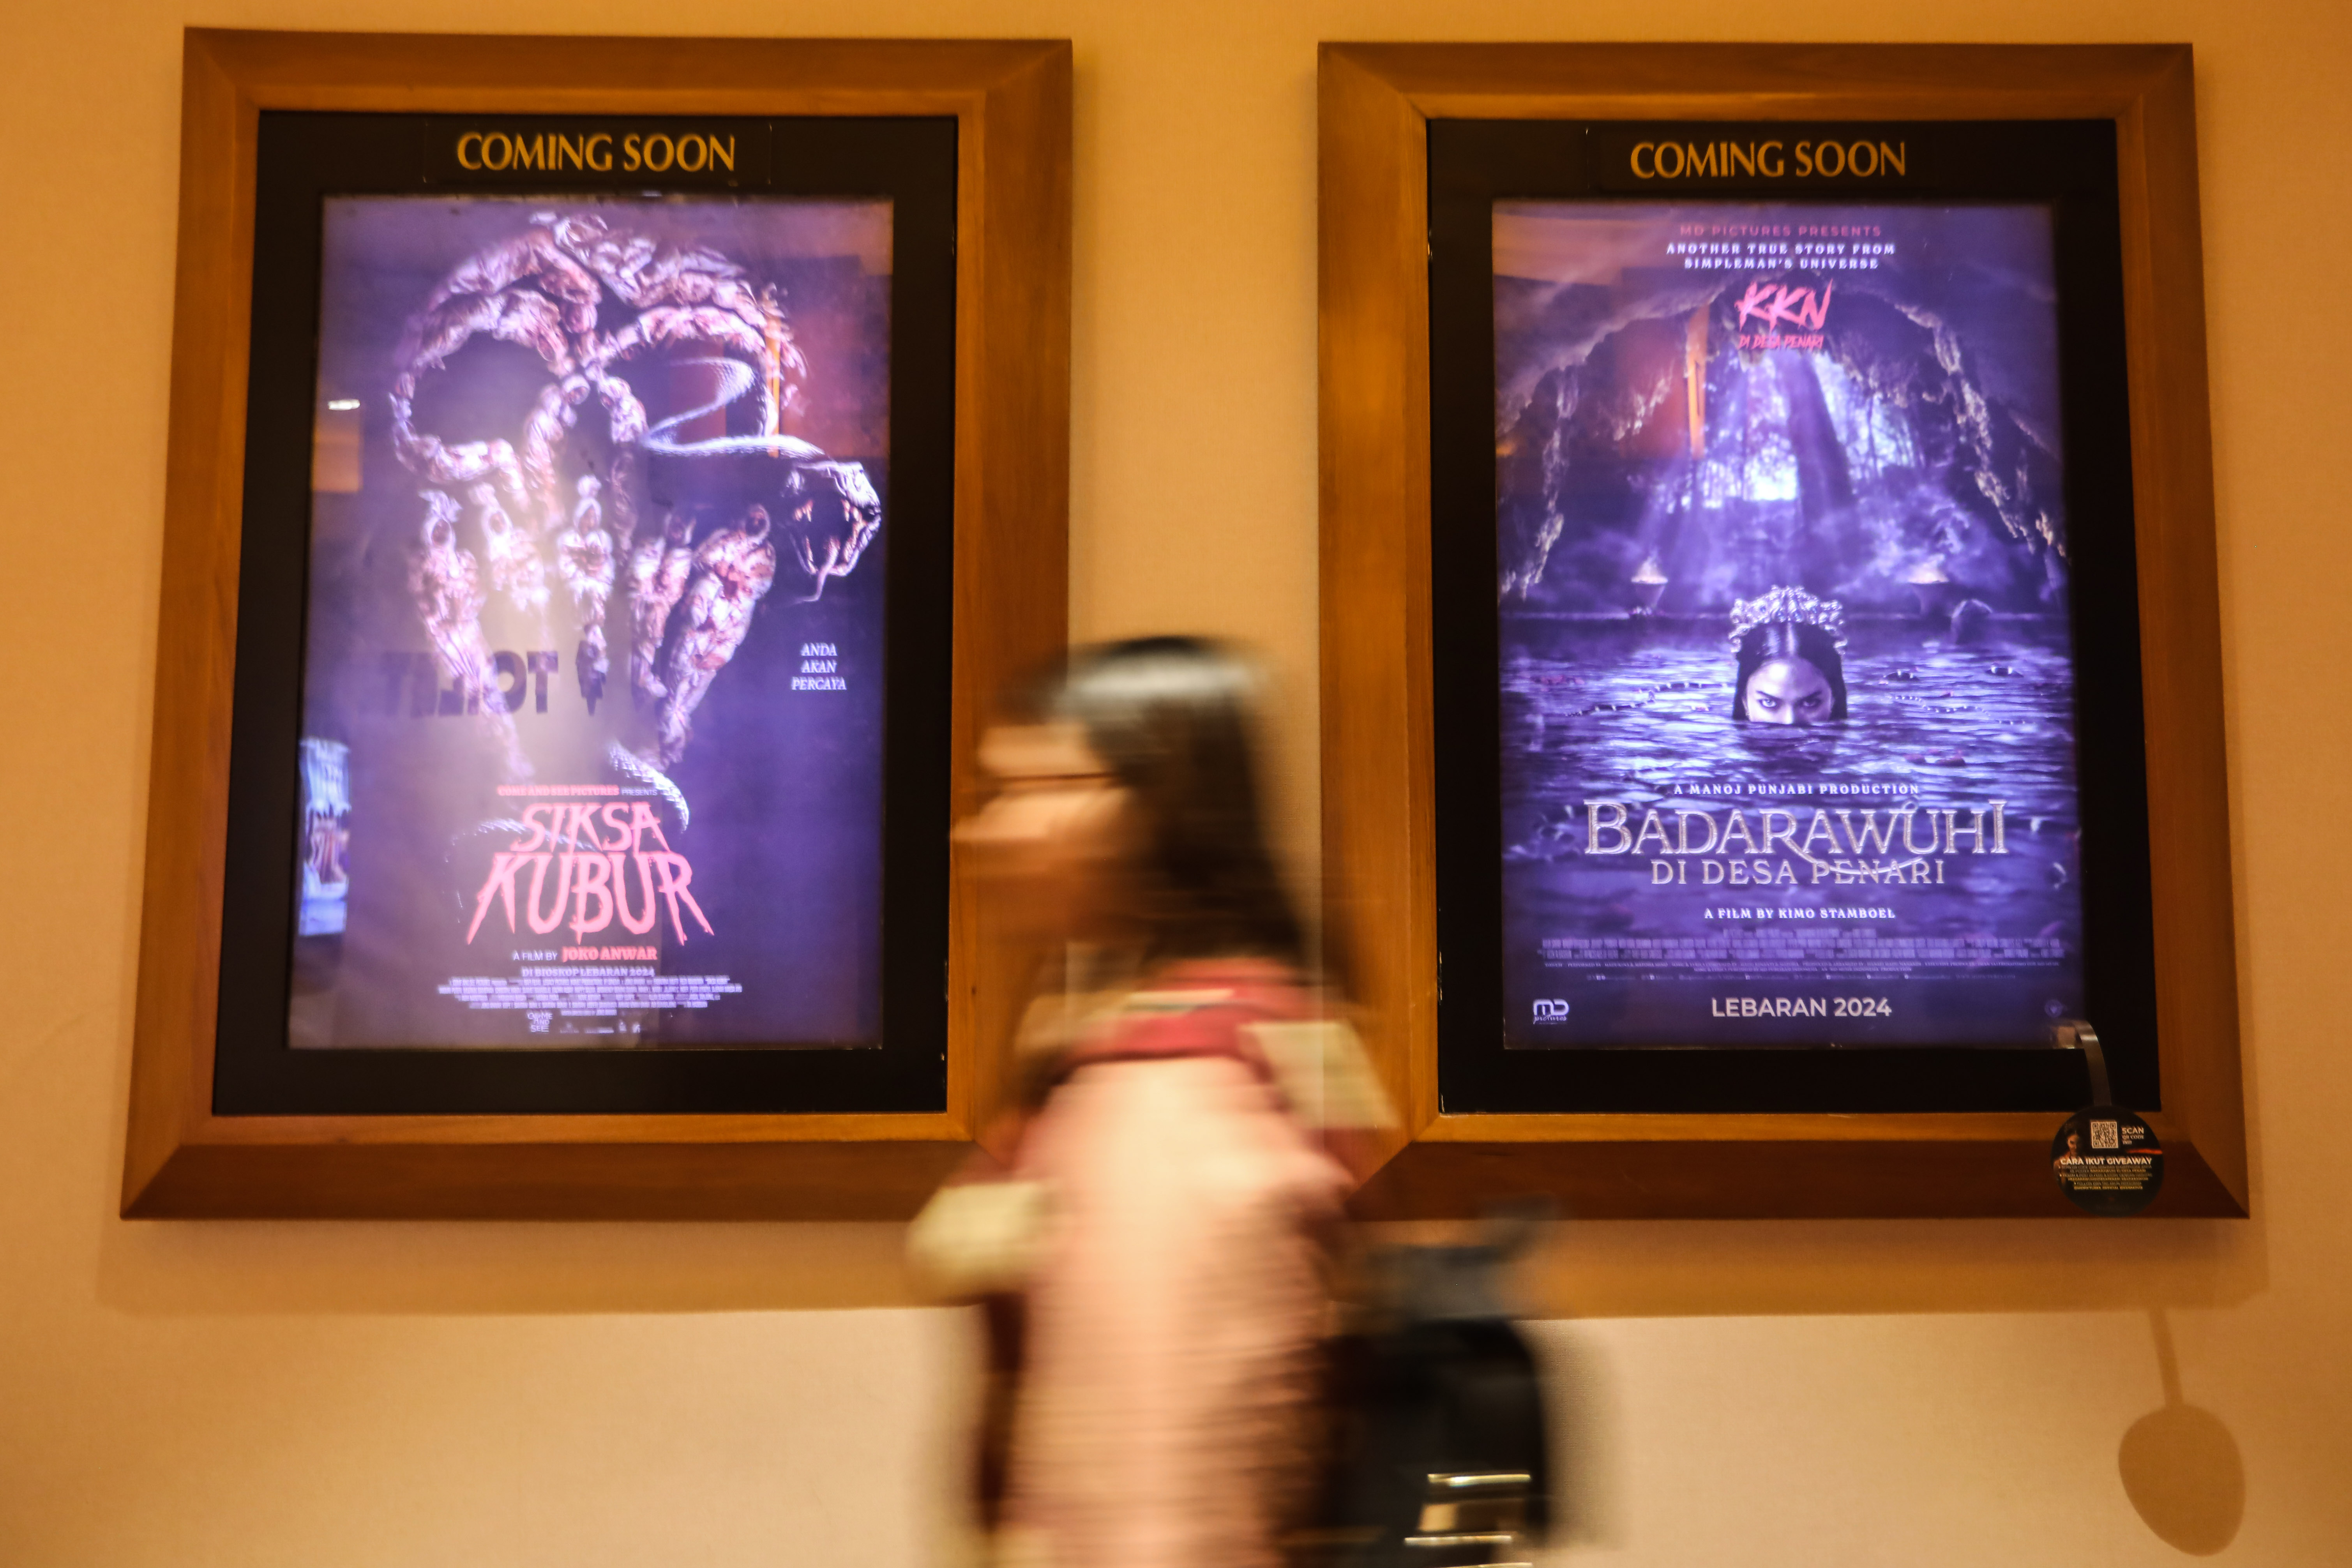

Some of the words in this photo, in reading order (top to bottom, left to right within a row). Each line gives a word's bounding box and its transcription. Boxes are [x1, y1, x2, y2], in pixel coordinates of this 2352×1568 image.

[457, 131, 613, 171] COMING
[623, 132, 735, 172] SOON
[1630, 141, 1785, 178] COMING
[1795, 141, 1905, 177] SOON
[1680, 225, 1704, 236] MD
[1712, 225, 1791, 237] PICTURES
[1799, 225, 1881, 237] PRESENTS
[1666, 242, 1741, 254] ANOTHER
[1747, 242, 1788, 254] TRUE
[1795, 242, 1845, 254] STORY
[1852, 242, 1895, 255] FROM
[1684, 257, 1792, 269] SIMPLEMAN'S
[1800, 258, 1878, 270] UNIVERSE
[1734, 278, 1833, 332] KKN
[801, 643, 838, 656] ANDA
[801, 660, 837, 673] AKAN
[791, 676, 847, 690] PERCAYA
[527, 785, 549, 796] AND
[570, 785, 619, 795] PICTURES
[622, 787, 658, 796] PRESENTS
[1674, 783, 1683, 794] A
[1690, 783, 1741, 795] MANOJ
[1748, 783, 1813, 794] PUNJABI
[1819, 783, 1919, 794] PRODUCTION
[510, 802, 670, 854] SIKSA
[1583, 798, 2008, 873] BADARAWUHI
[1651, 859, 1687, 885] DI
[1702, 859, 1798, 885] DESA
[1812, 858, 1944, 885] PENARI
[468, 851, 715, 946] KUBUR
[1704, 908, 1713, 918] A
[1718, 908, 1752, 918] FILM
[1757, 908, 1773, 918] BY
[1778, 908, 1815, 918] KIMO
[1819, 908, 1895, 918] STAMBOEL
[513, 951, 520, 961] A
[523, 951, 543, 961] FILM
[546, 951, 558, 961] BY
[562, 946, 599, 962] JOKO
[600, 946, 658, 960] ANWAR
[580, 966, 629, 976] LEBARAN
[1712, 998, 1826, 1017] LEBARAN
[1833, 998, 1892, 1016] 2024
[2085, 1157, 2105, 1165] IKUT
[2107, 1156, 2152, 1165] GIVEAWAY
